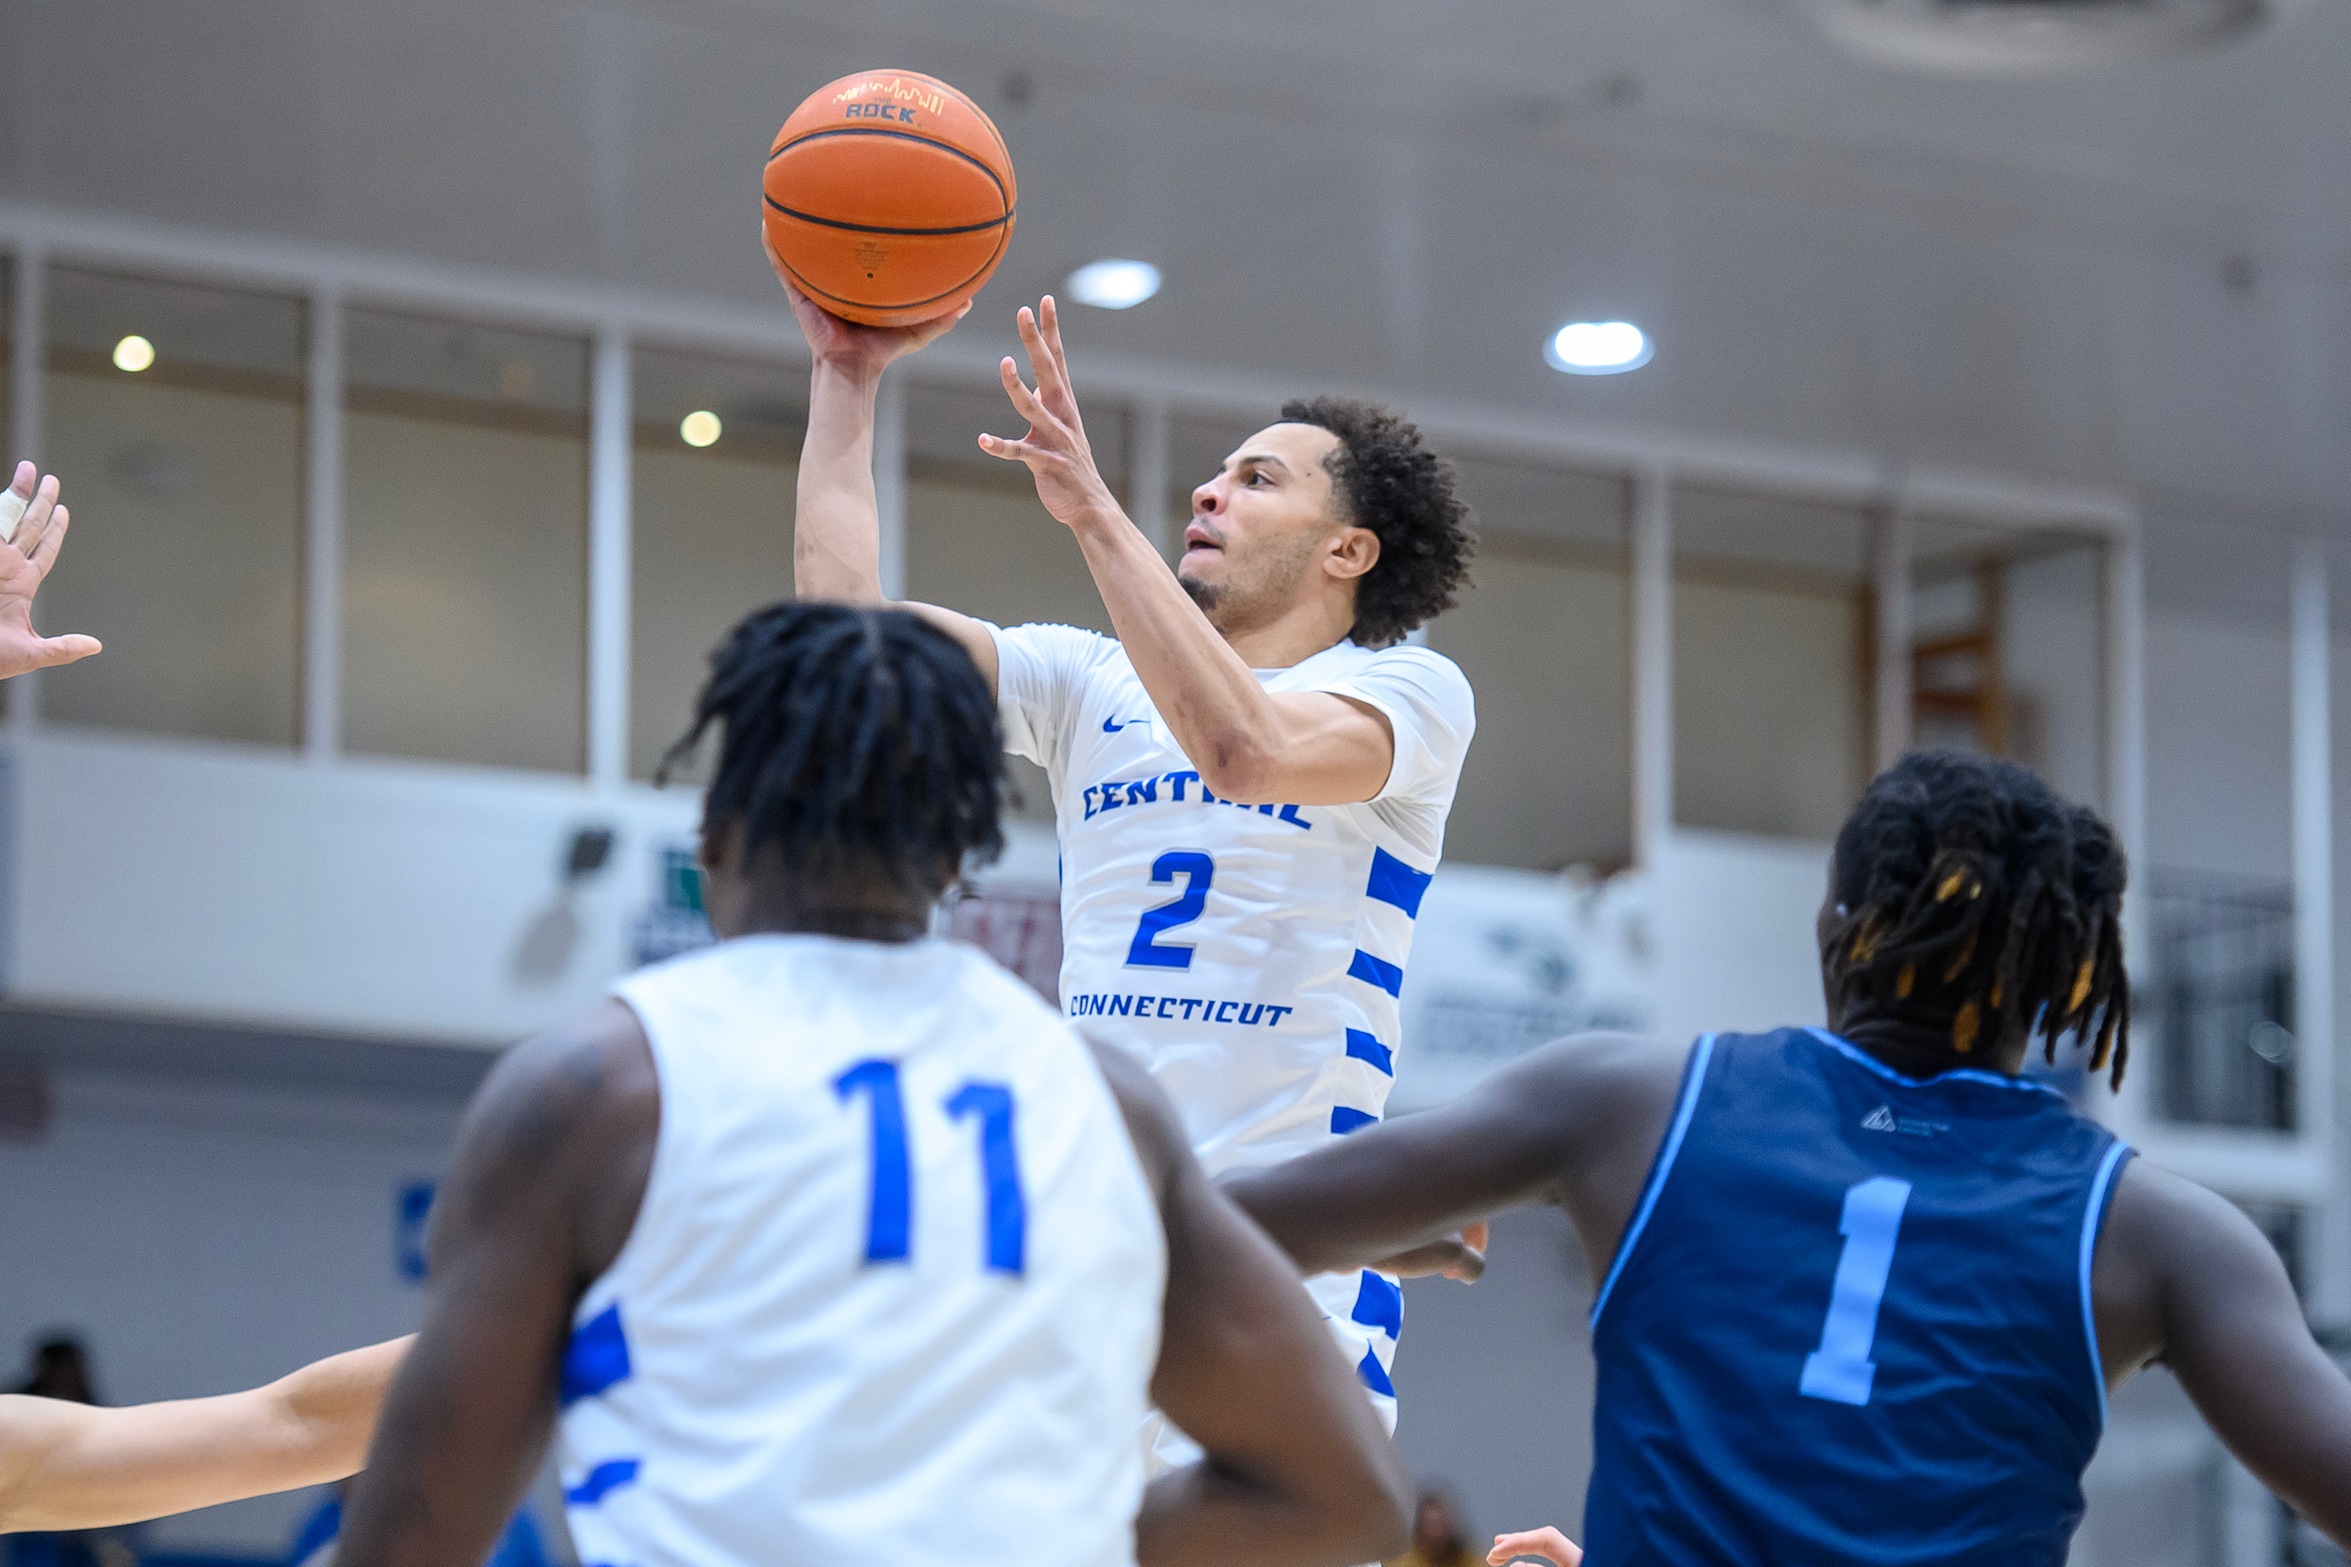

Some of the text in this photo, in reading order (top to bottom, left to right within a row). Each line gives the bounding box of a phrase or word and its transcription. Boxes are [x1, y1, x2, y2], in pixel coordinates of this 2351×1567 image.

[845, 103, 917, 124] ROCK
[1083, 771, 1312, 831] CENTL
[1122, 848, 1215, 973] 2
[1070, 994, 1293, 1027] CONNECTICUT
[829, 1057, 1028, 1278] 11
[1799, 1176, 1912, 1407] 1
